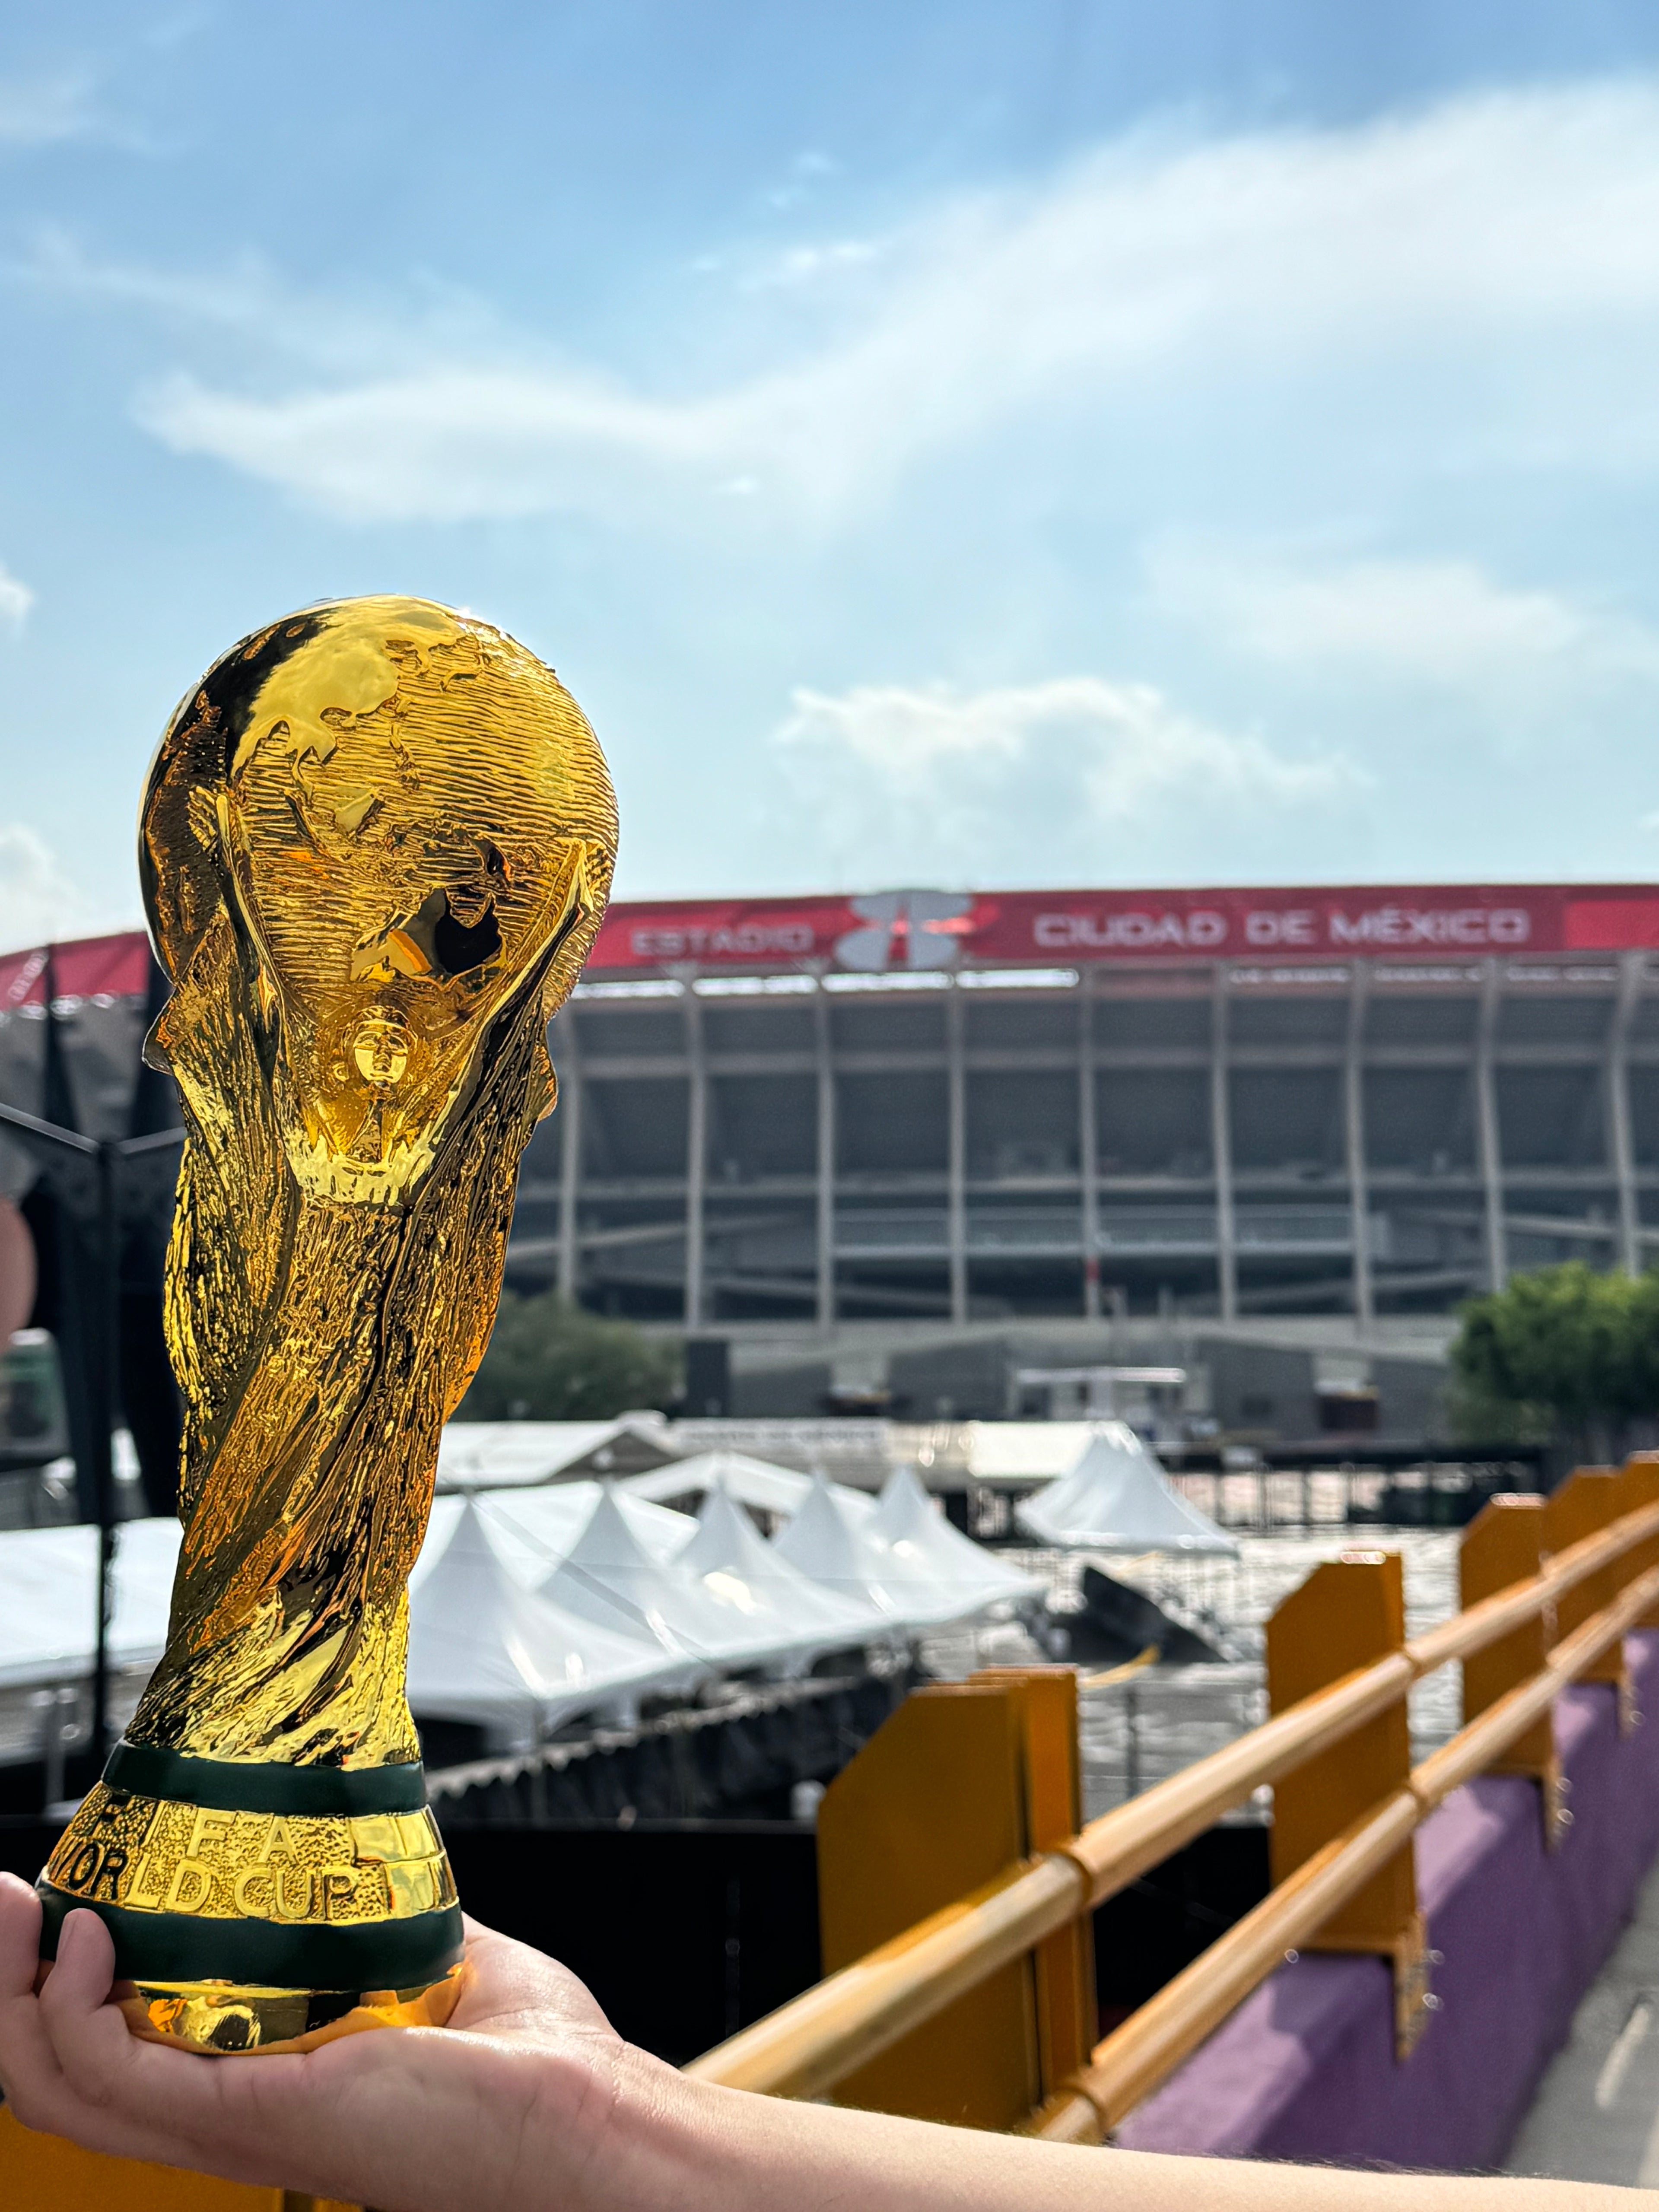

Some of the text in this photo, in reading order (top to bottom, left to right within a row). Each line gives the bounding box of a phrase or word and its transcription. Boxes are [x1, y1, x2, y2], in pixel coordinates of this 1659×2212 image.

[632, 906, 1529, 954] ESTADIO CIUDAD DE MÉXICO
[87, 1794, 299, 1864] FIFA
[234, 1867, 358, 1920] CUP
